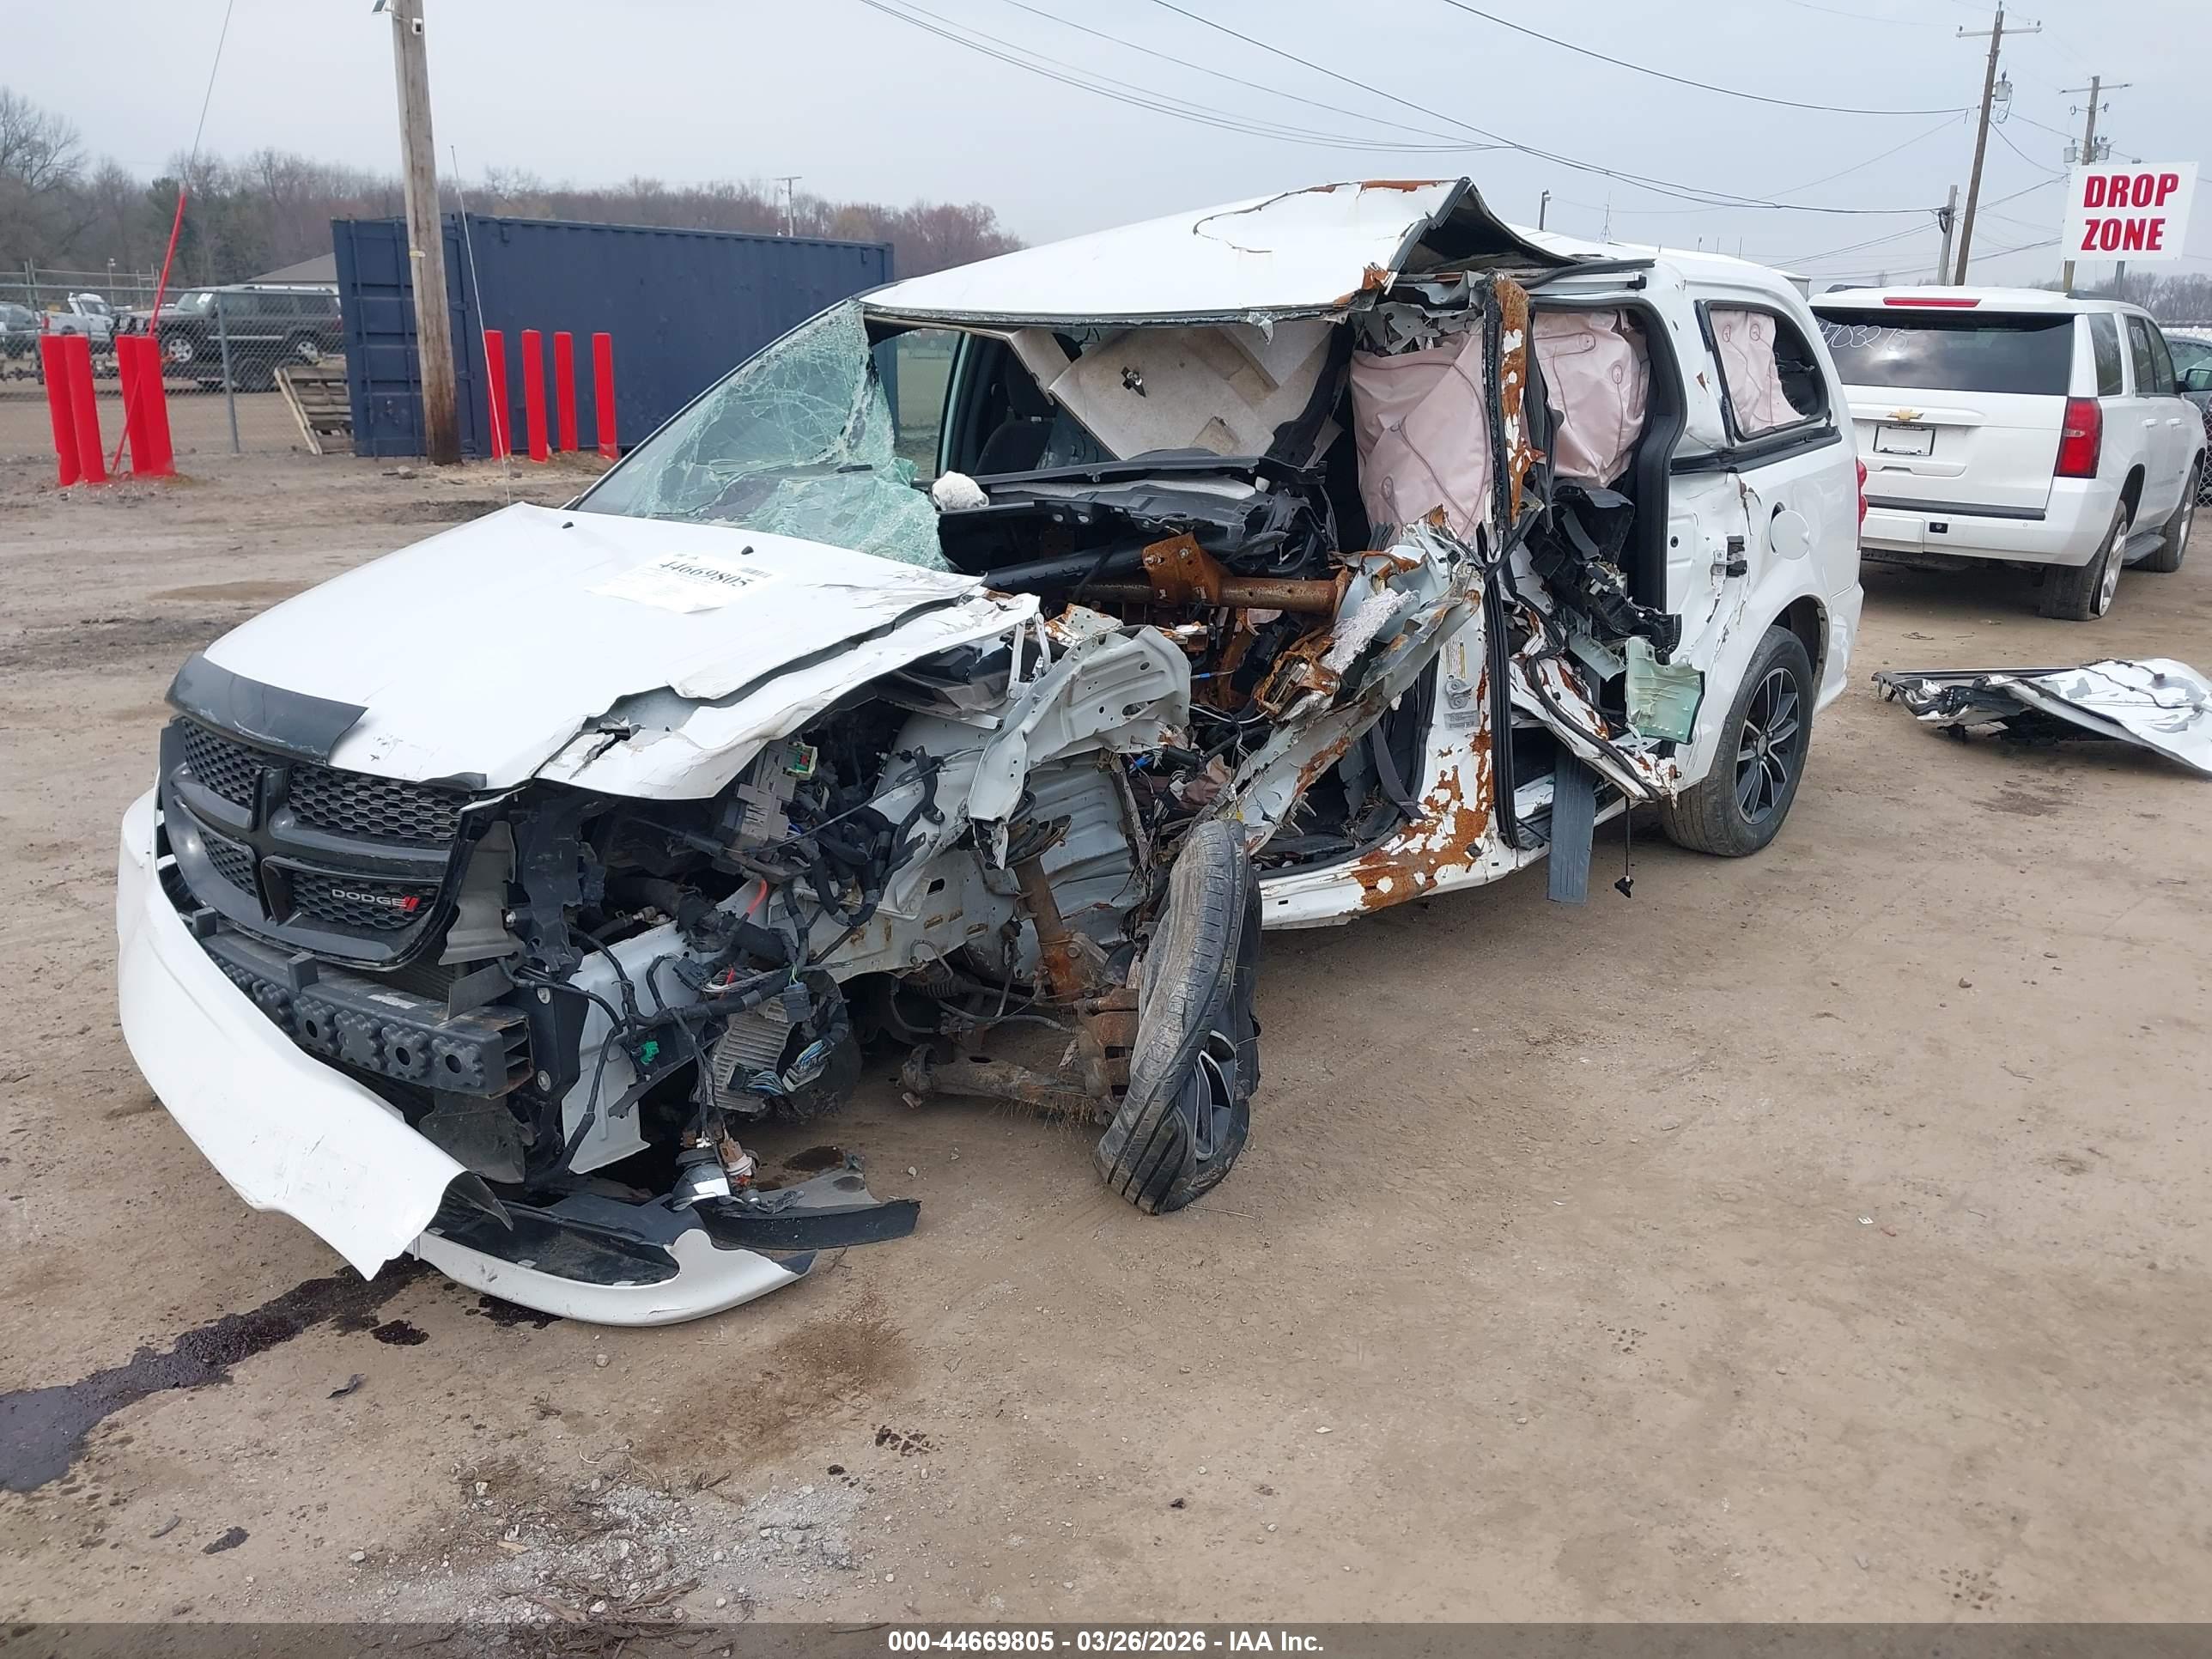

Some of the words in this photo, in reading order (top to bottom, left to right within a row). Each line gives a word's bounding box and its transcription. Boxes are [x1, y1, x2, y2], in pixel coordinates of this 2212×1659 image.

[2083, 173, 2179, 208] DROP
[2081, 218, 2166, 251] ZONE
[659, 561, 755, 587] 44669805
[331, 889, 407, 908] DODGE
